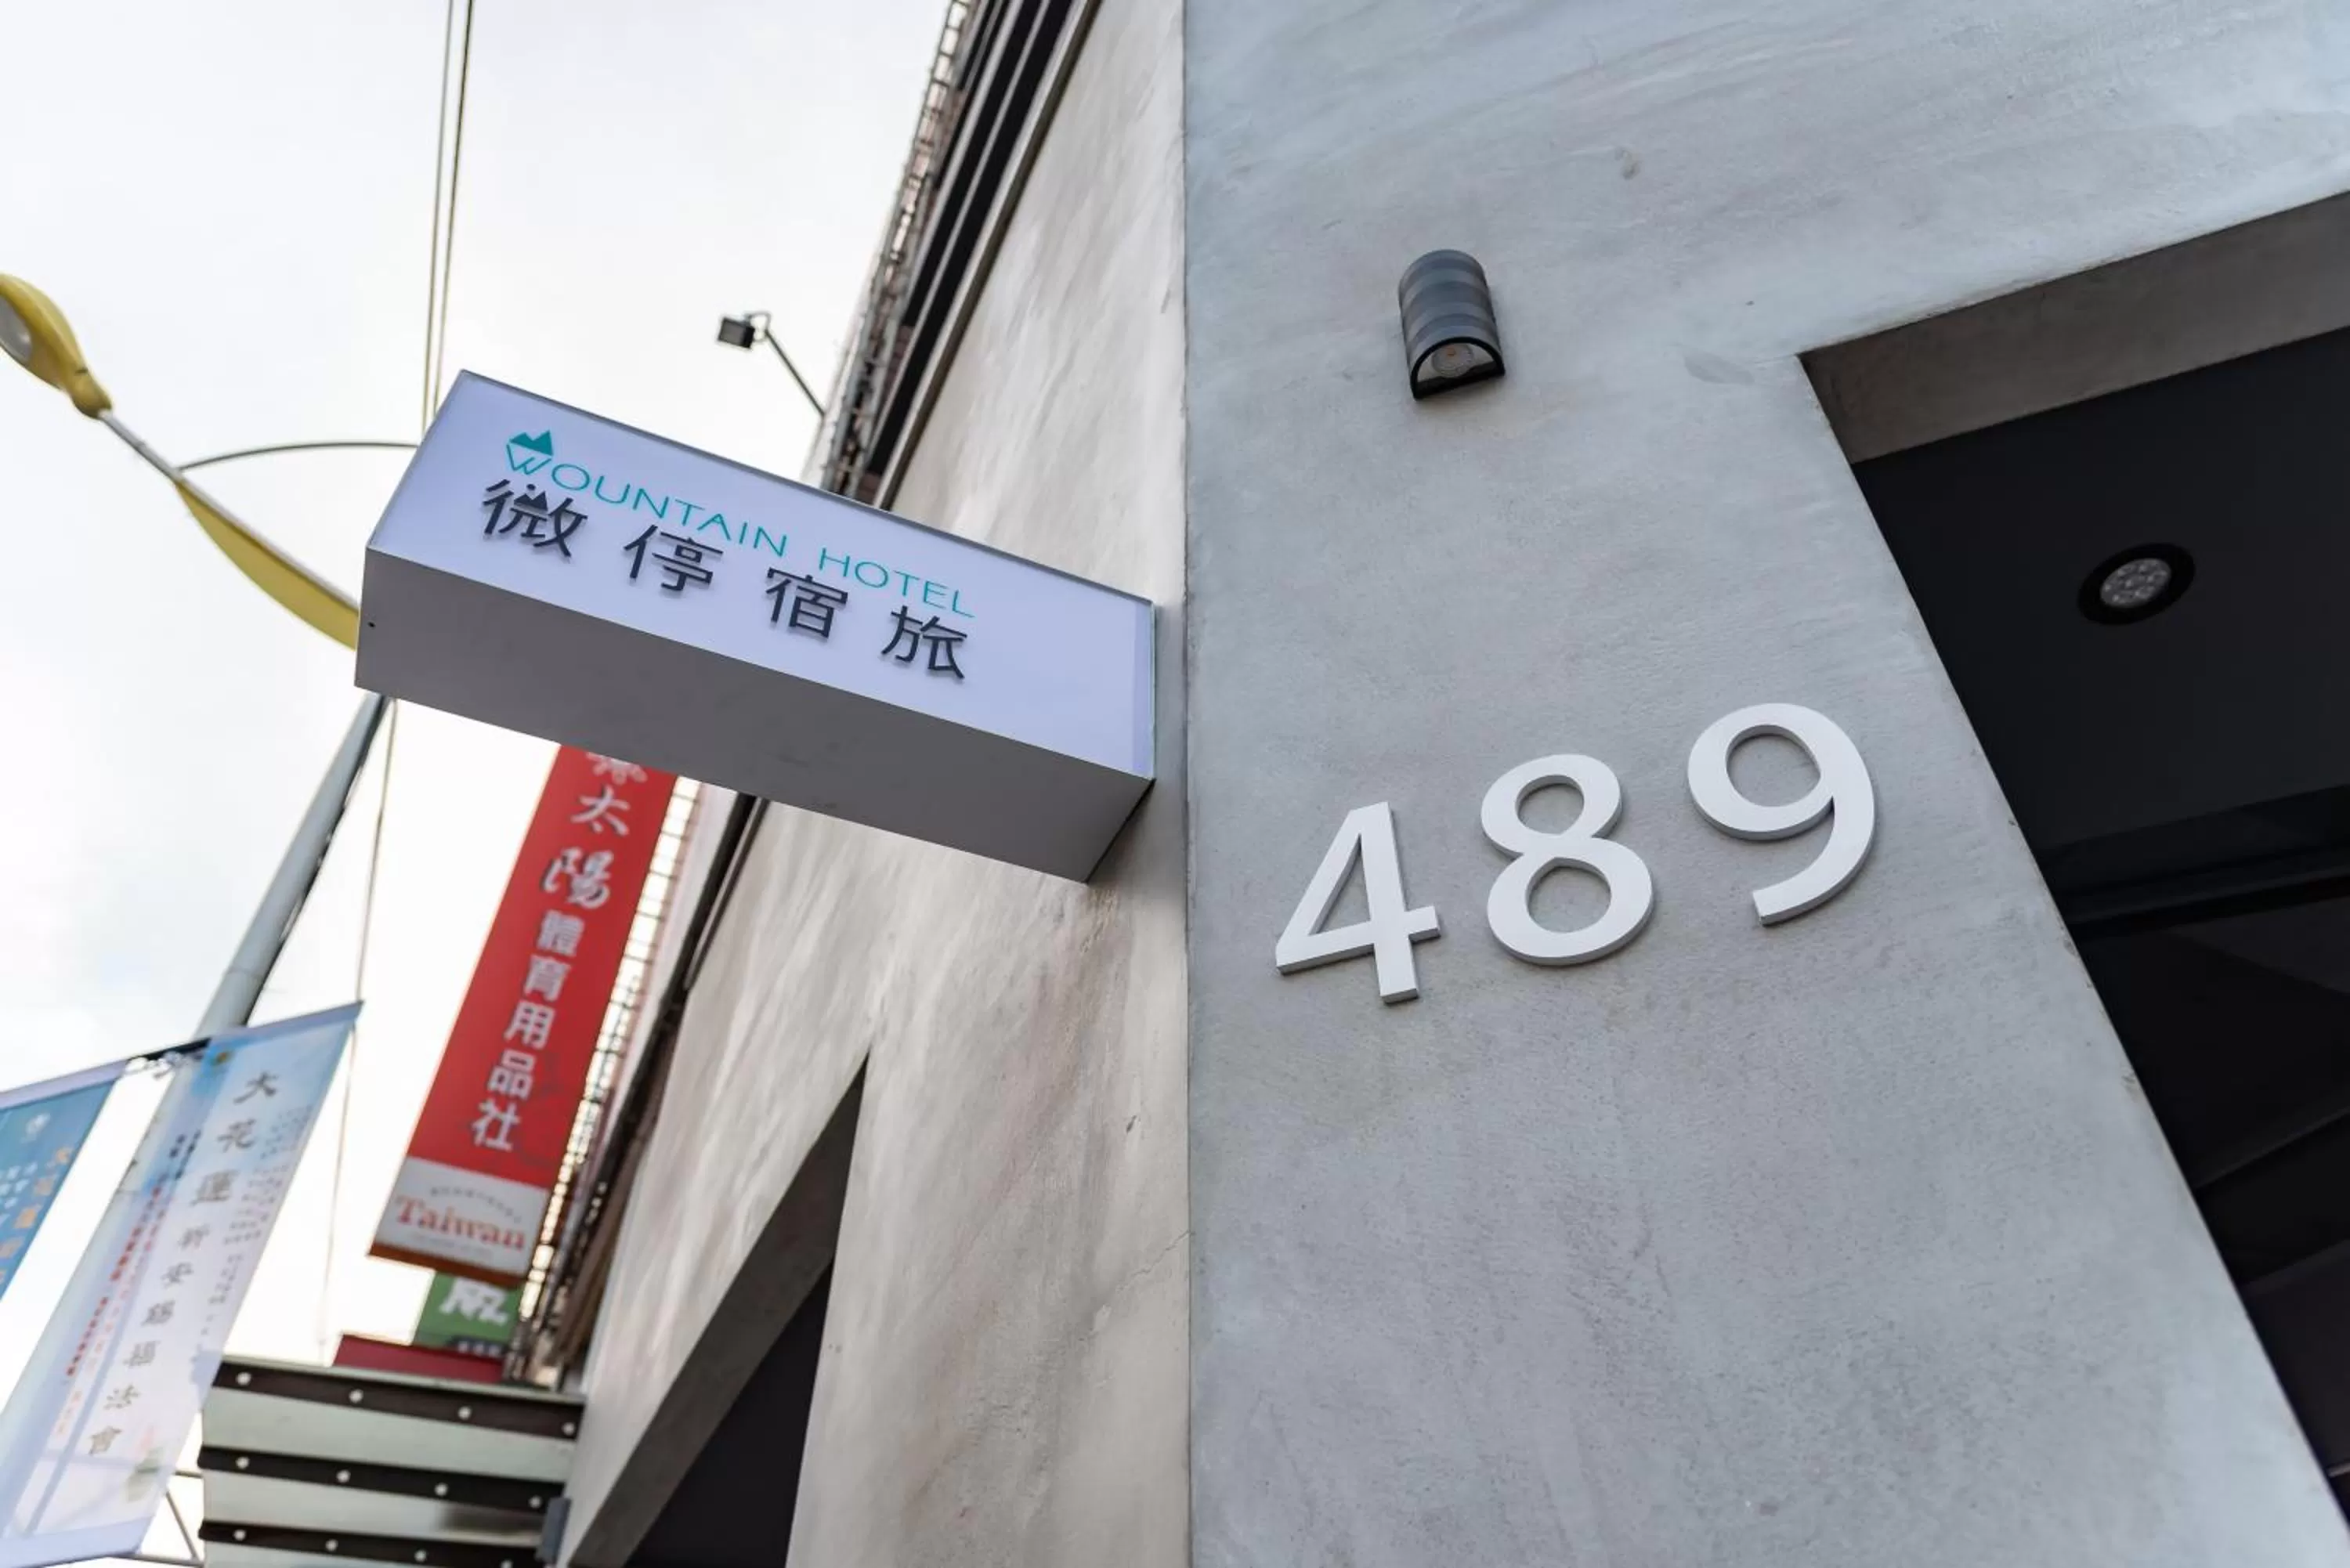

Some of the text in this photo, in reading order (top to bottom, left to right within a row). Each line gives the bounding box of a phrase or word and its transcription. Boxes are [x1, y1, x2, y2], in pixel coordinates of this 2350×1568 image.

[482, 479, 969, 680] 微停宿旅
[818, 547, 976, 618] HOTEL
[1275, 703, 1876, 1004] 489
[396, 1195, 526, 1252] Taiwan
